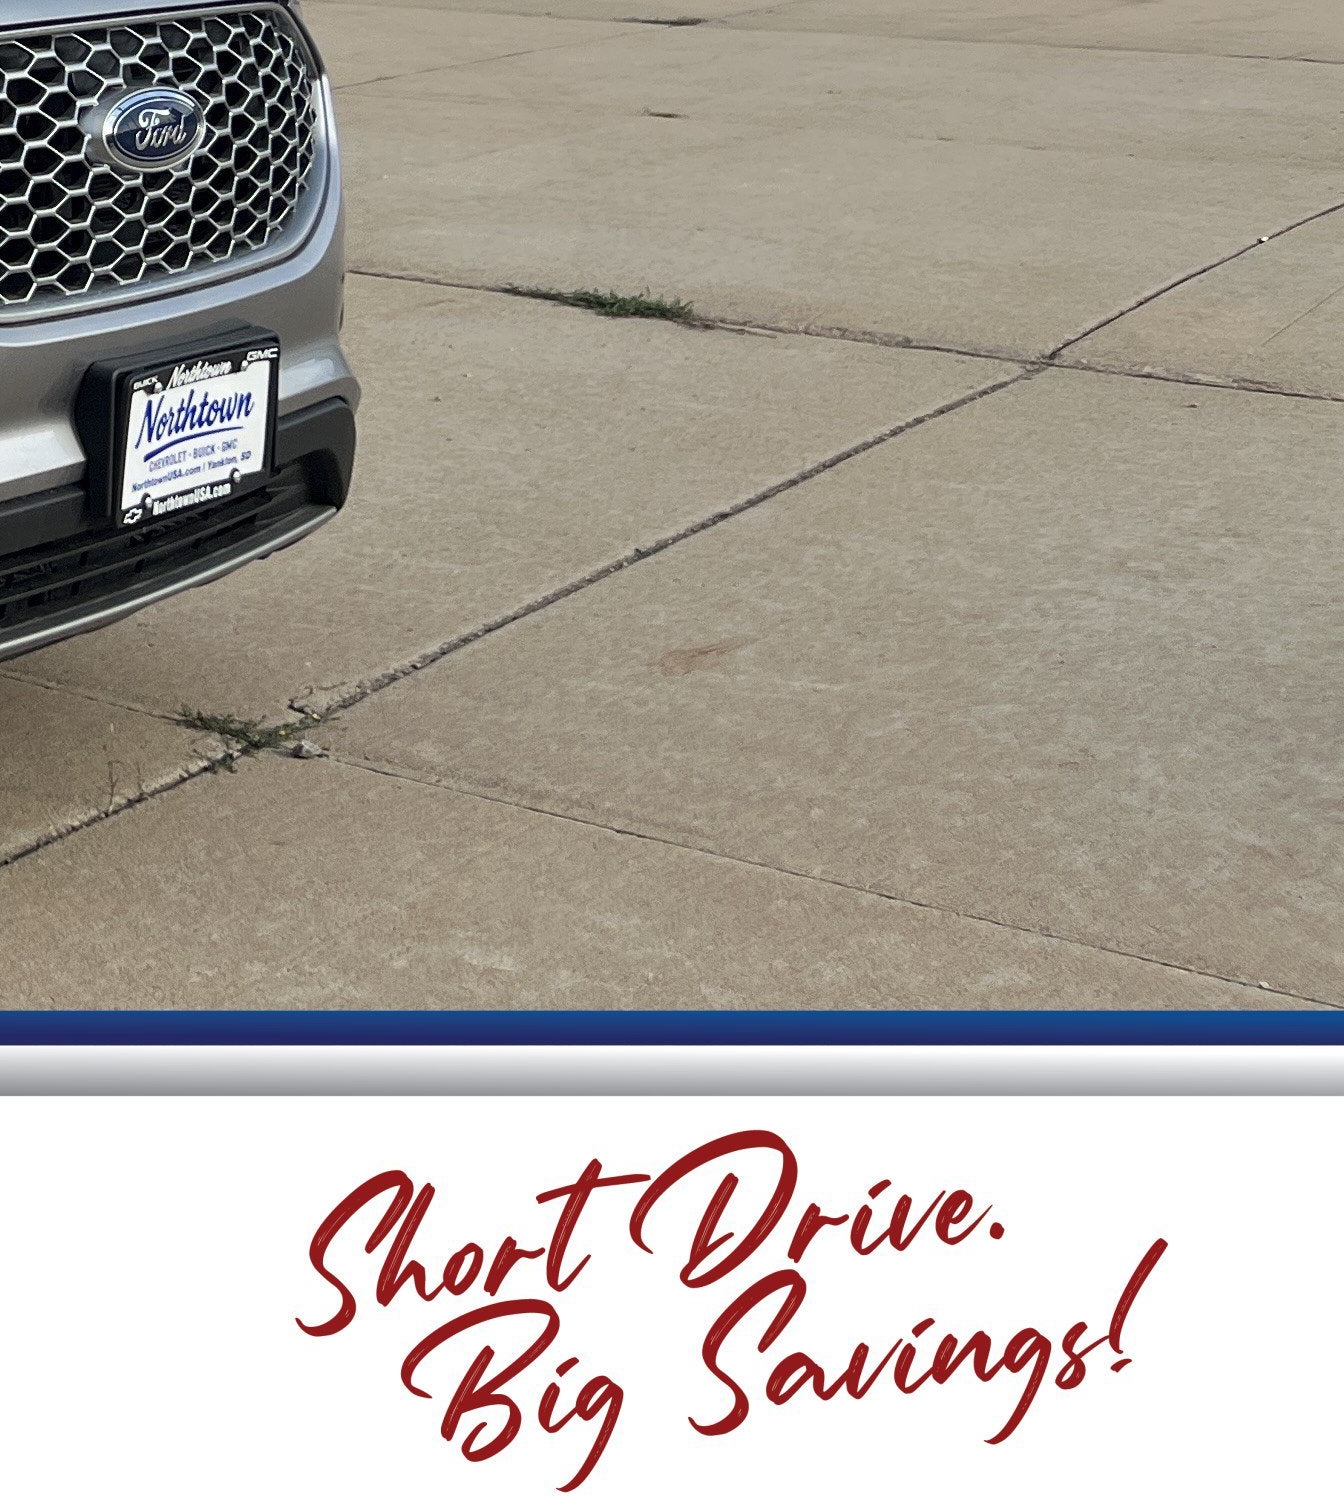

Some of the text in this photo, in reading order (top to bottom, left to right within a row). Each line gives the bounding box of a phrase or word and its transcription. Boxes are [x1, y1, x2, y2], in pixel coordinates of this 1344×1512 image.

[135, 108, 187, 151] Ford
[246, 347, 279, 362] GMC
[132, 375, 159, 390] BUICK
[166, 360, 233, 389] Northtown
[134, 388, 255, 449] Northtown
[131, 465, 202, 492] NorthtownUSA.com
[240, 450, 252, 462] SD
[148, 438, 238, 473] CHEVROLET BUICK GMC
[151, 482, 232, 516] NorthtownUSA.com
